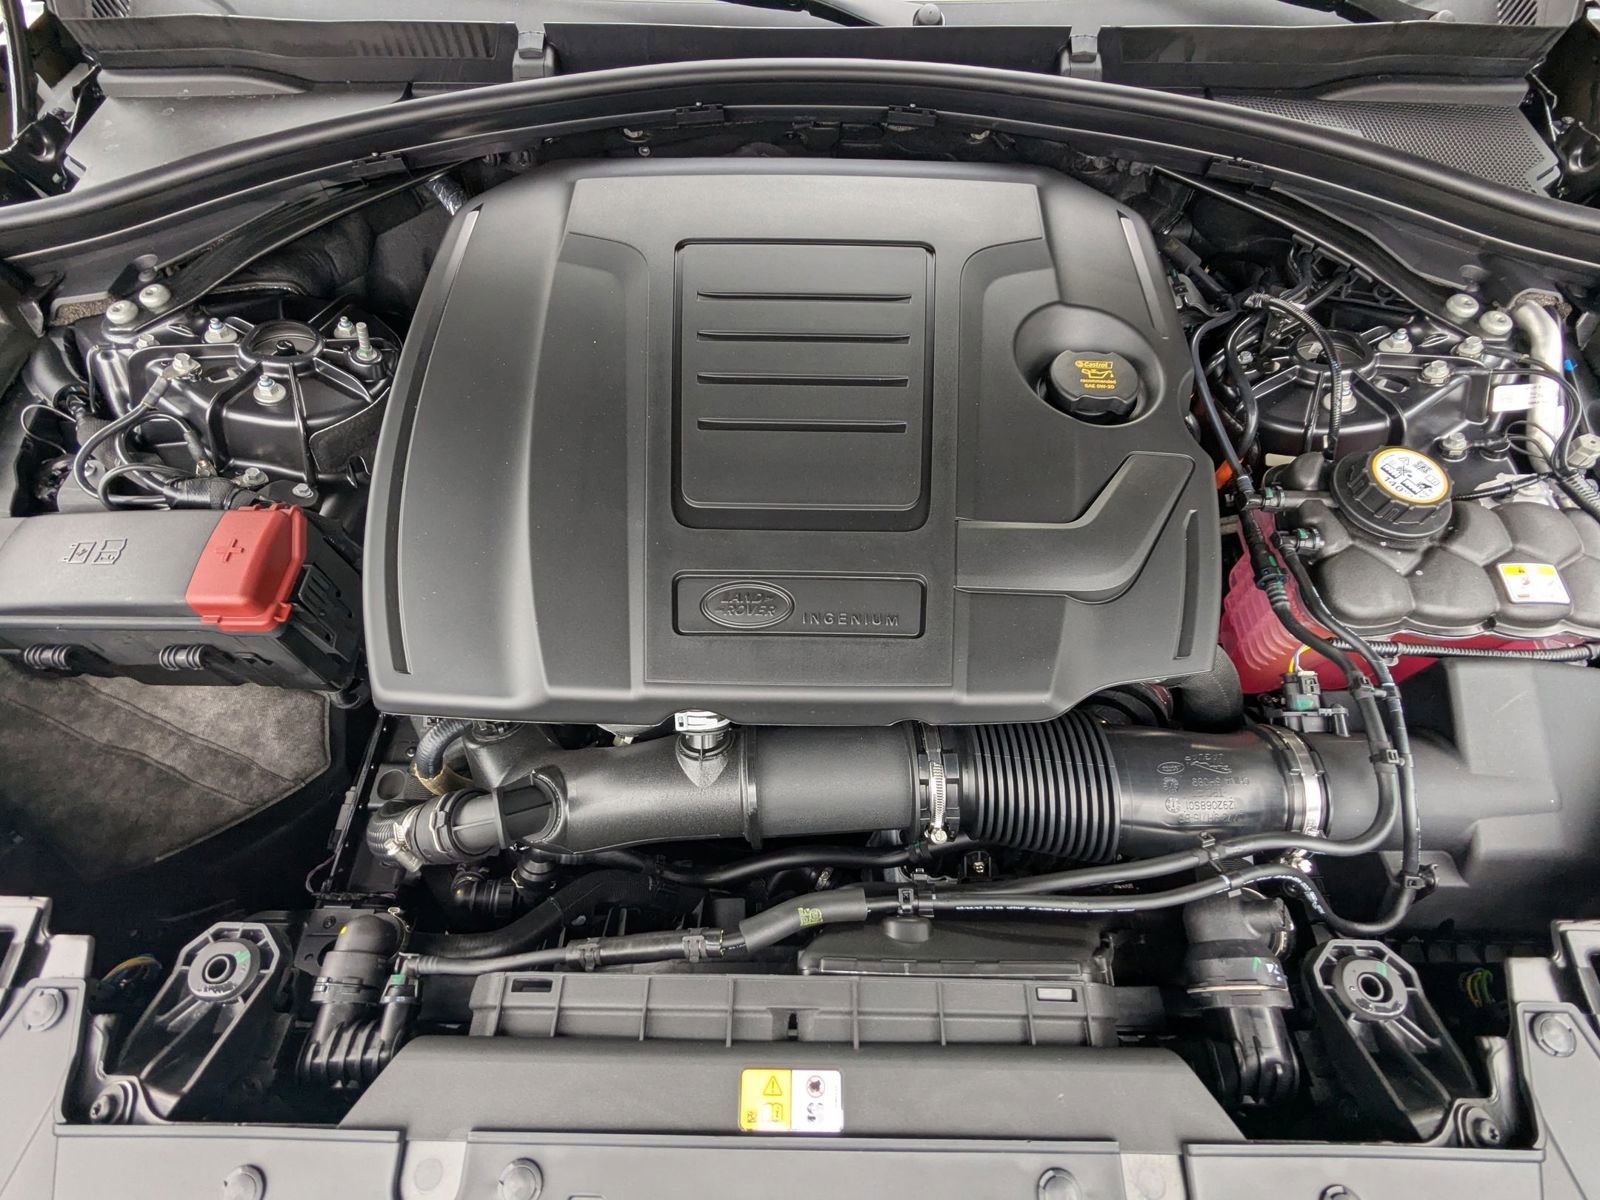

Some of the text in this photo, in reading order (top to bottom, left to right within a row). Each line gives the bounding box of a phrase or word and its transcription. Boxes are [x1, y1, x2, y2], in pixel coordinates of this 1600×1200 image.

[1084, 361, 1108, 369] Castrol
[720, 592, 763, 604] LAND
[723, 605, 776, 617] ROVER
[802, 612, 899, 627] INGENIUM
